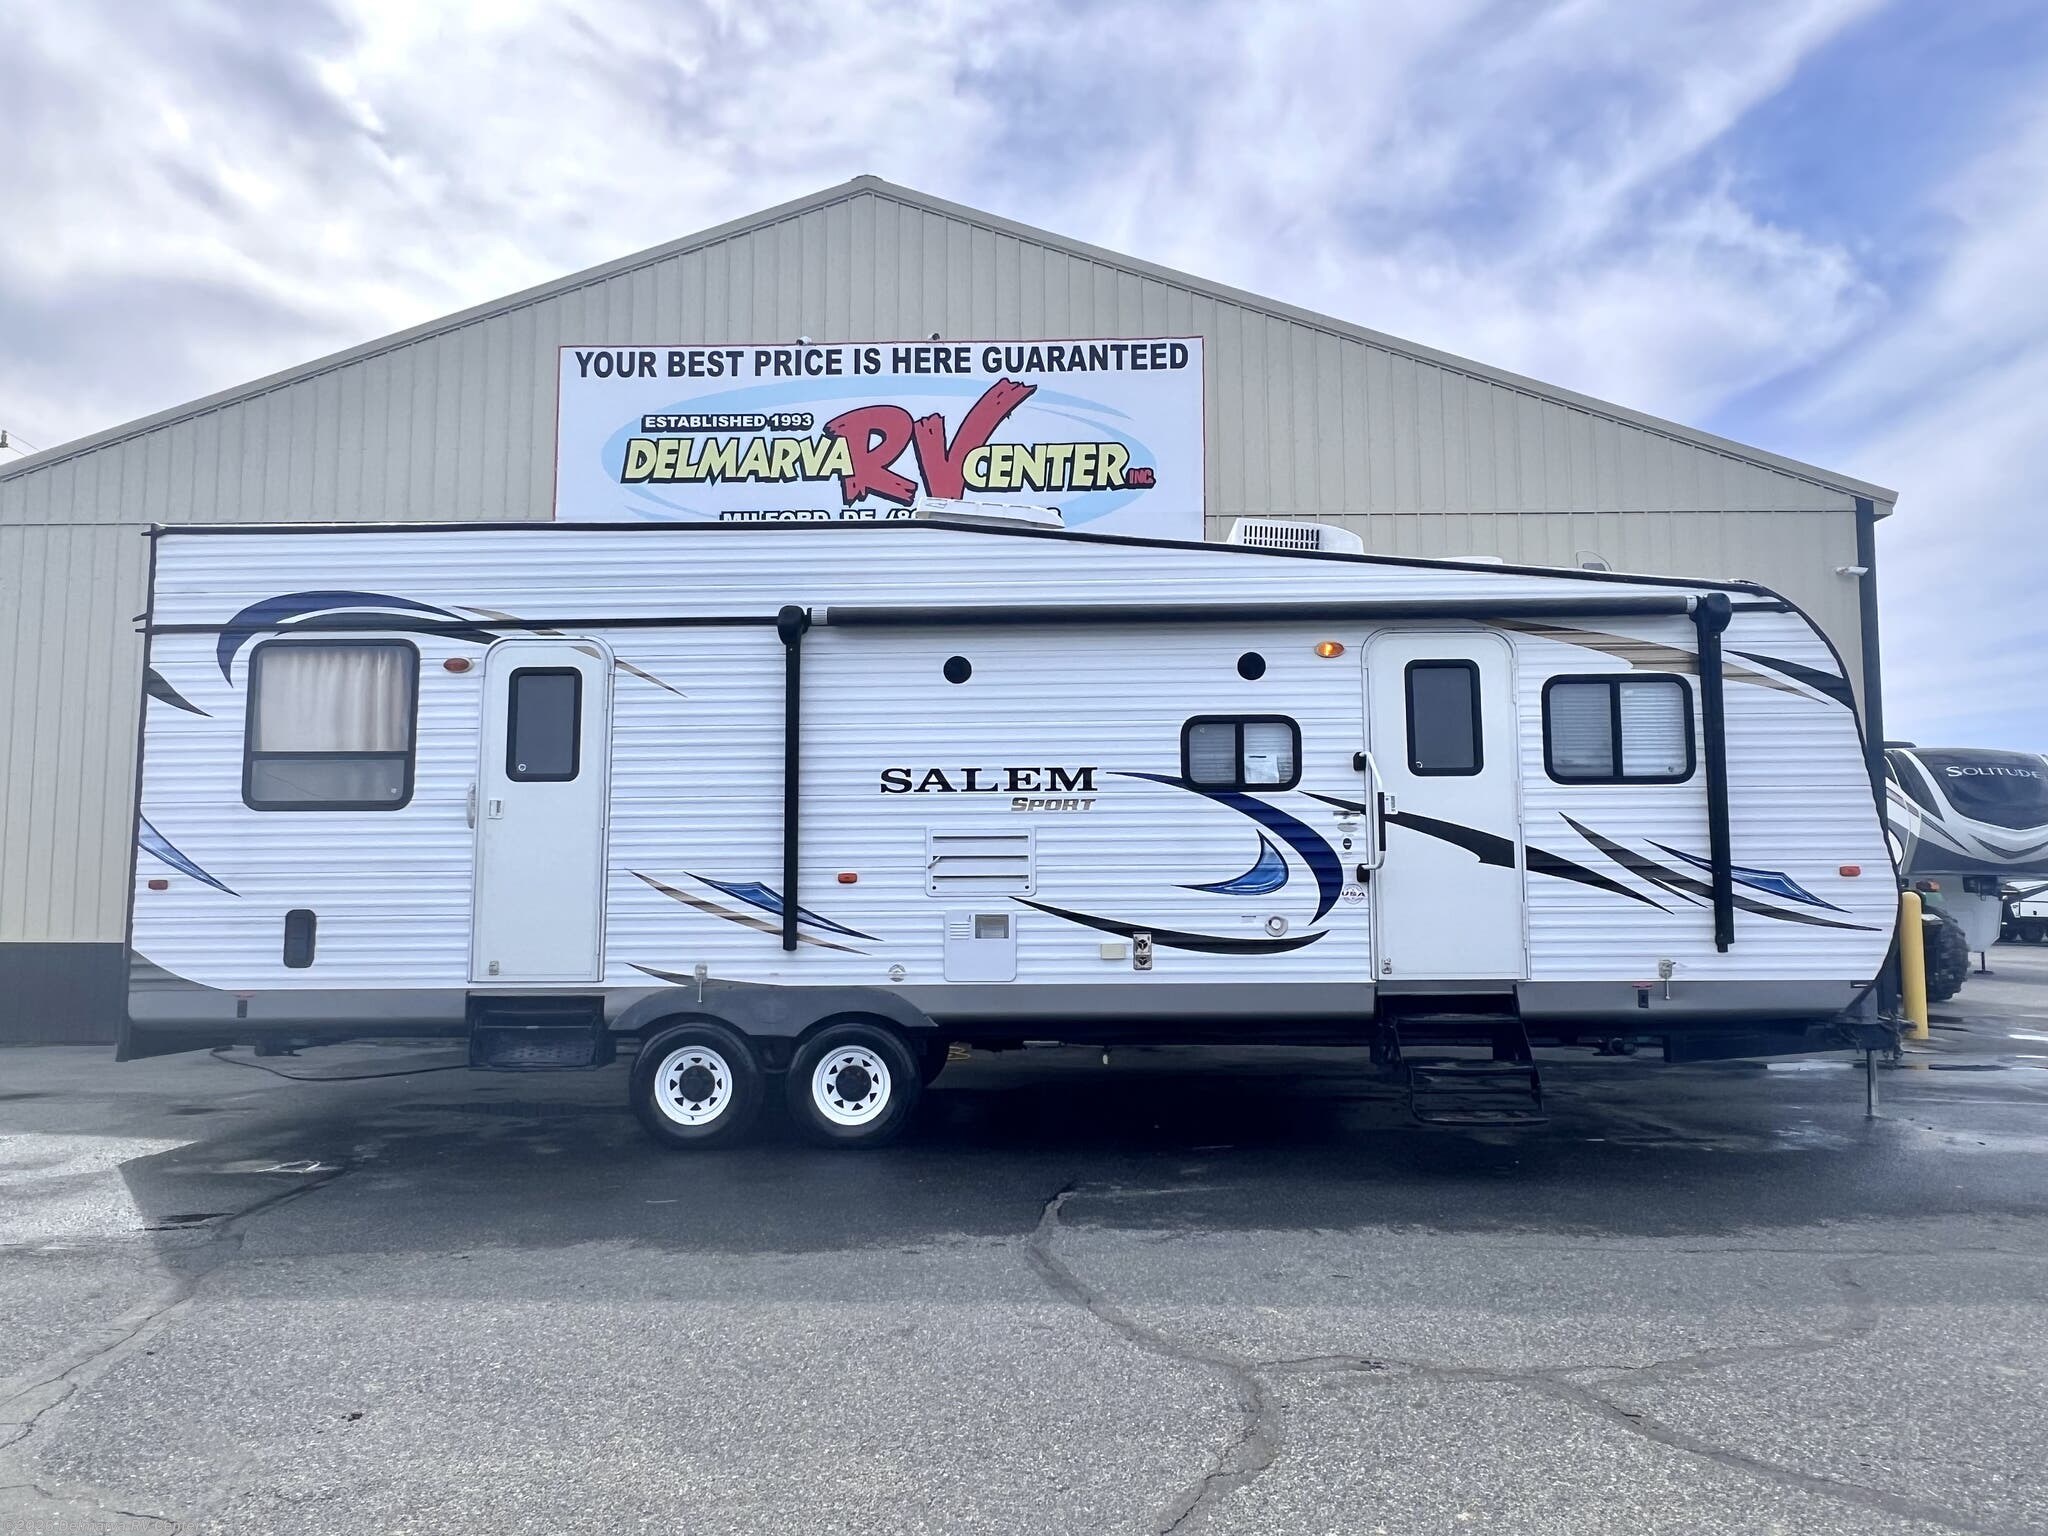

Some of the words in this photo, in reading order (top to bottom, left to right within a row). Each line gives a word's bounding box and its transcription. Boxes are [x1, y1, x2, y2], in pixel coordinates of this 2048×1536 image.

[575, 351, 657, 378] YOUR
[667, 351, 744, 377] BEST
[754, 348, 843, 376] PRICE
[854, 348, 883, 375] IS
[892, 347, 971, 373] HERE
[982, 343, 1188, 373] GUARANTEED
[643, 414, 766, 429] ESTABLISHED
[770, 413, 813, 428] 1993
[621, 436, 854, 484] DELMARVA
[823, 377, 1037, 506] RV
[962, 442, 1130, 492] CENTER
[880, 767, 1098, 793] SALEM
[1945, 766, 2042, 779] SOLITUDE
[1011, 797, 1096, 812] SPORT
[1341, 890, 1366, 898] USA
